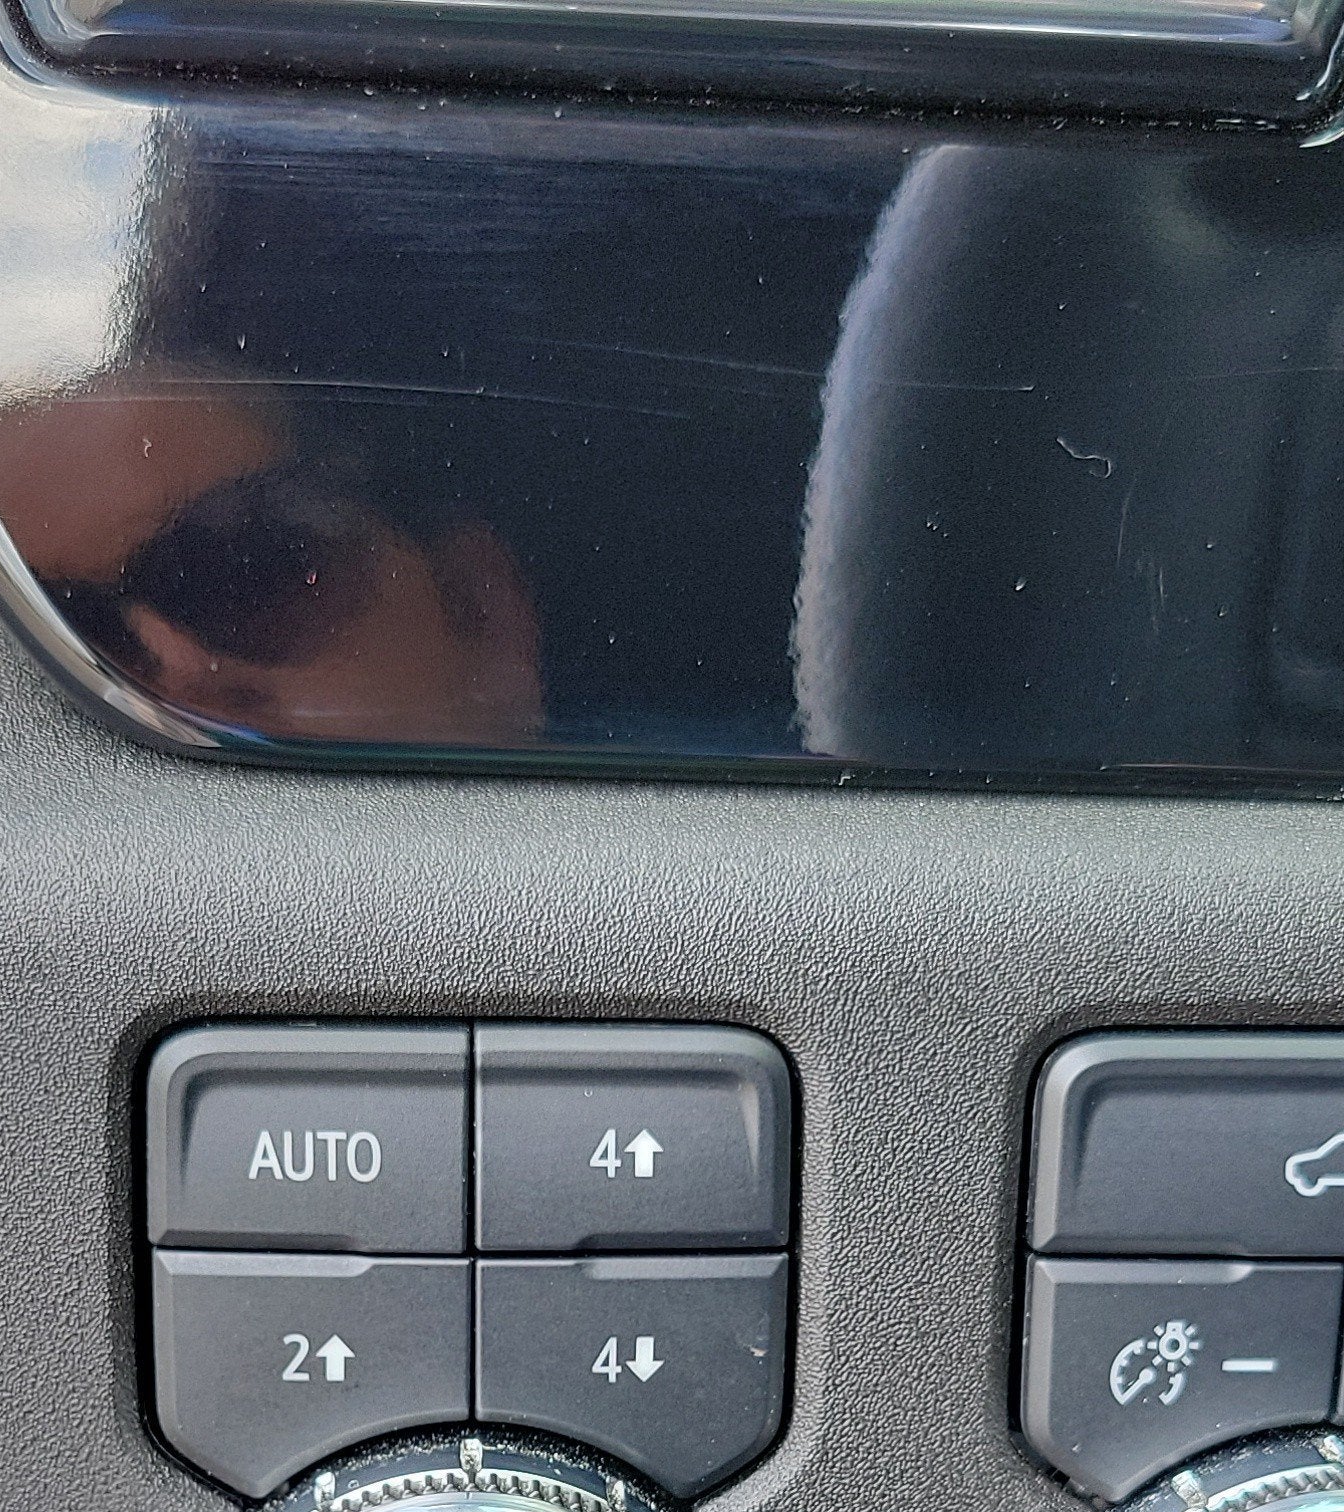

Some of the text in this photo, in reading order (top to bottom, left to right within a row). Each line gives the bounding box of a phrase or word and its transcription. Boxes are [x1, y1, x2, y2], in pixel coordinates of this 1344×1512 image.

[248, 1130, 382, 1183] AUTO
[588, 1129, 622, 1178] 4
[281, 1333, 311, 1382] 2
[591, 1336, 623, 1383] 4
